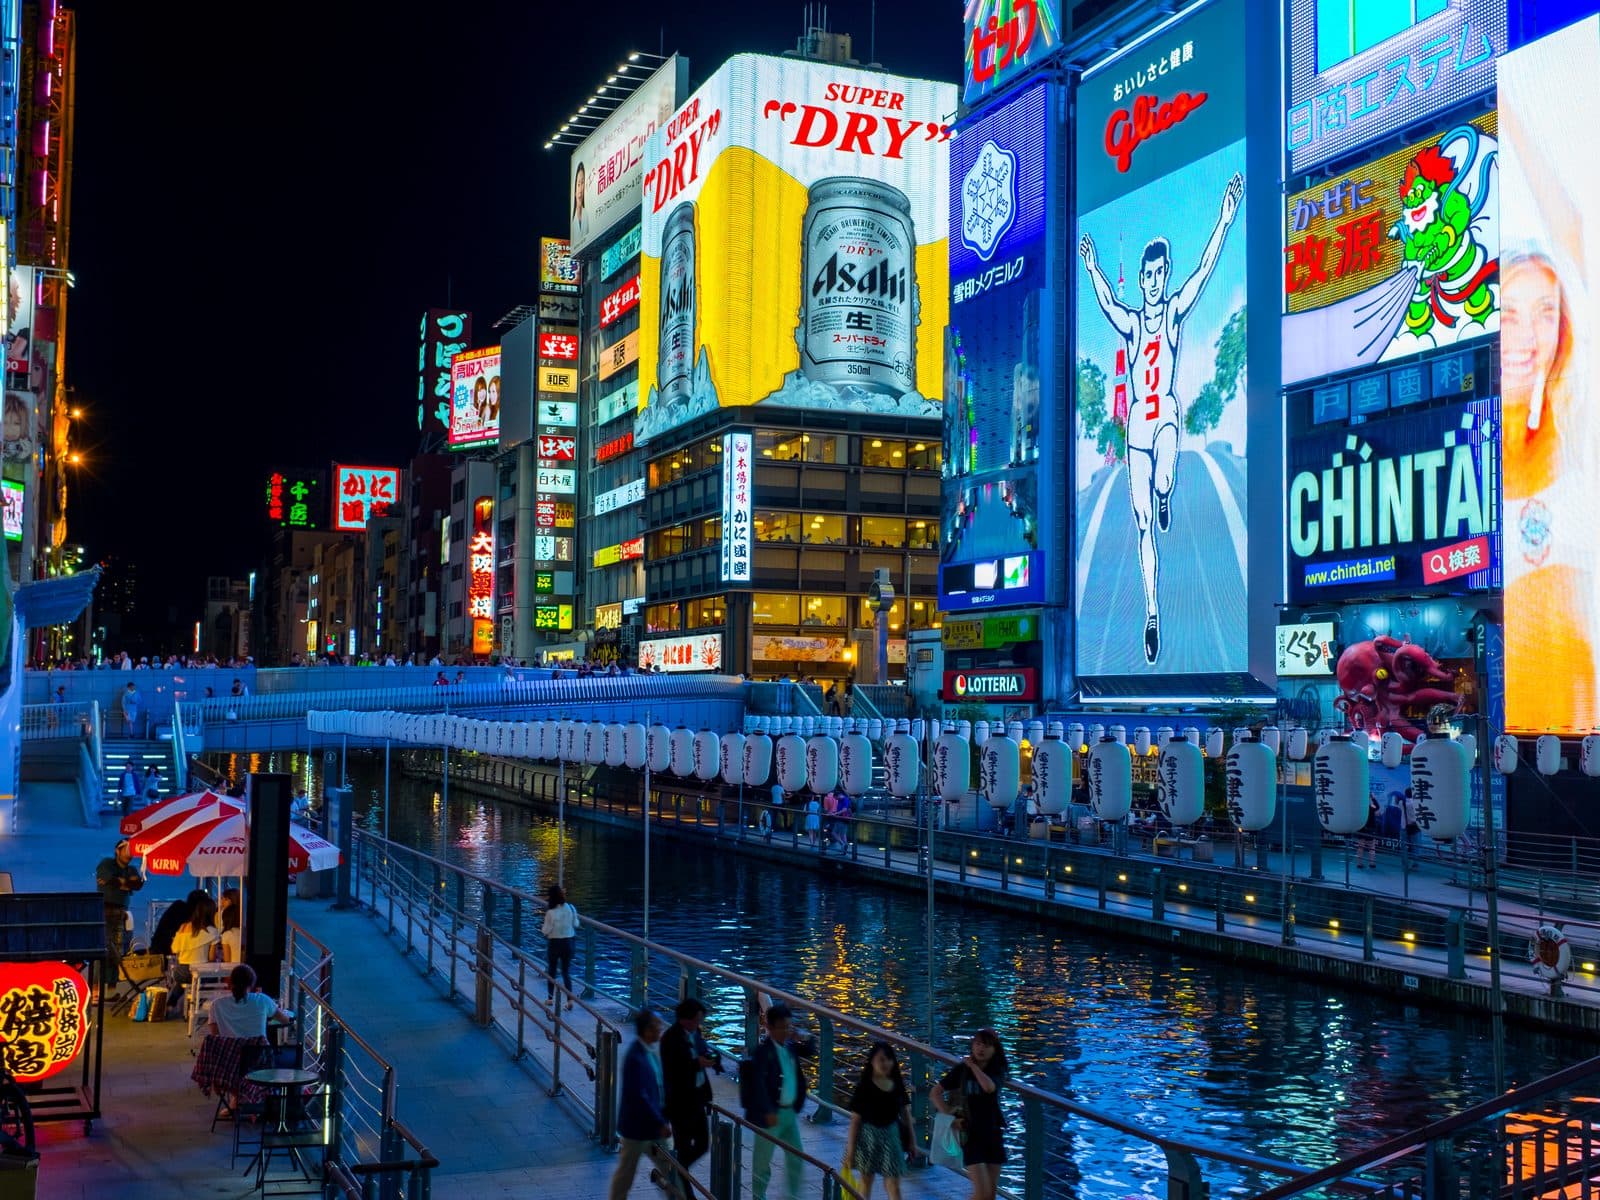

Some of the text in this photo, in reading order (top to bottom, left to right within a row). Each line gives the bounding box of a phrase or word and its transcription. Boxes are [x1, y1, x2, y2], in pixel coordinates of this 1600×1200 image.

[825, 83, 905, 110] SUPER
[1113, 41, 1195, 102] おいしさと健康
[1287, 24, 1496, 152] 日商エステム
[666, 97, 700, 147] SUPER
[1105, 92, 1209, 172] Glico
[1291, 177, 1374, 232] かぜに
[1284, 208, 1384, 294] 改源
[812, 251, 906, 305] Asahi
[953, 256, 1025, 304] 雪印メグミルク
[833, 334, 887, 347] スーパードライ
[846, 311, 873, 331] 生
[456, 361, 485, 380] 高収入
[847, 364, 871, 376] 350ml
[1143, 334, 1162, 422] グリコ
[539, 472, 573, 487] 白木屋
[1290, 425, 1497, 557] CHINTAI
[734, 509, 748, 576] かに道楽
[1448, 546, 1481, 571] 検索
[967, 675, 1018, 693] LOTTERIA
[1165, 756, 1179, 806] 電子マネー
[1315, 755, 1335, 825] 三津寺
[1411, 756, 1437, 830] 三津寺
[152, 858, 180, 871] KIRIN
[198, 846, 246, 855] KIRIN
